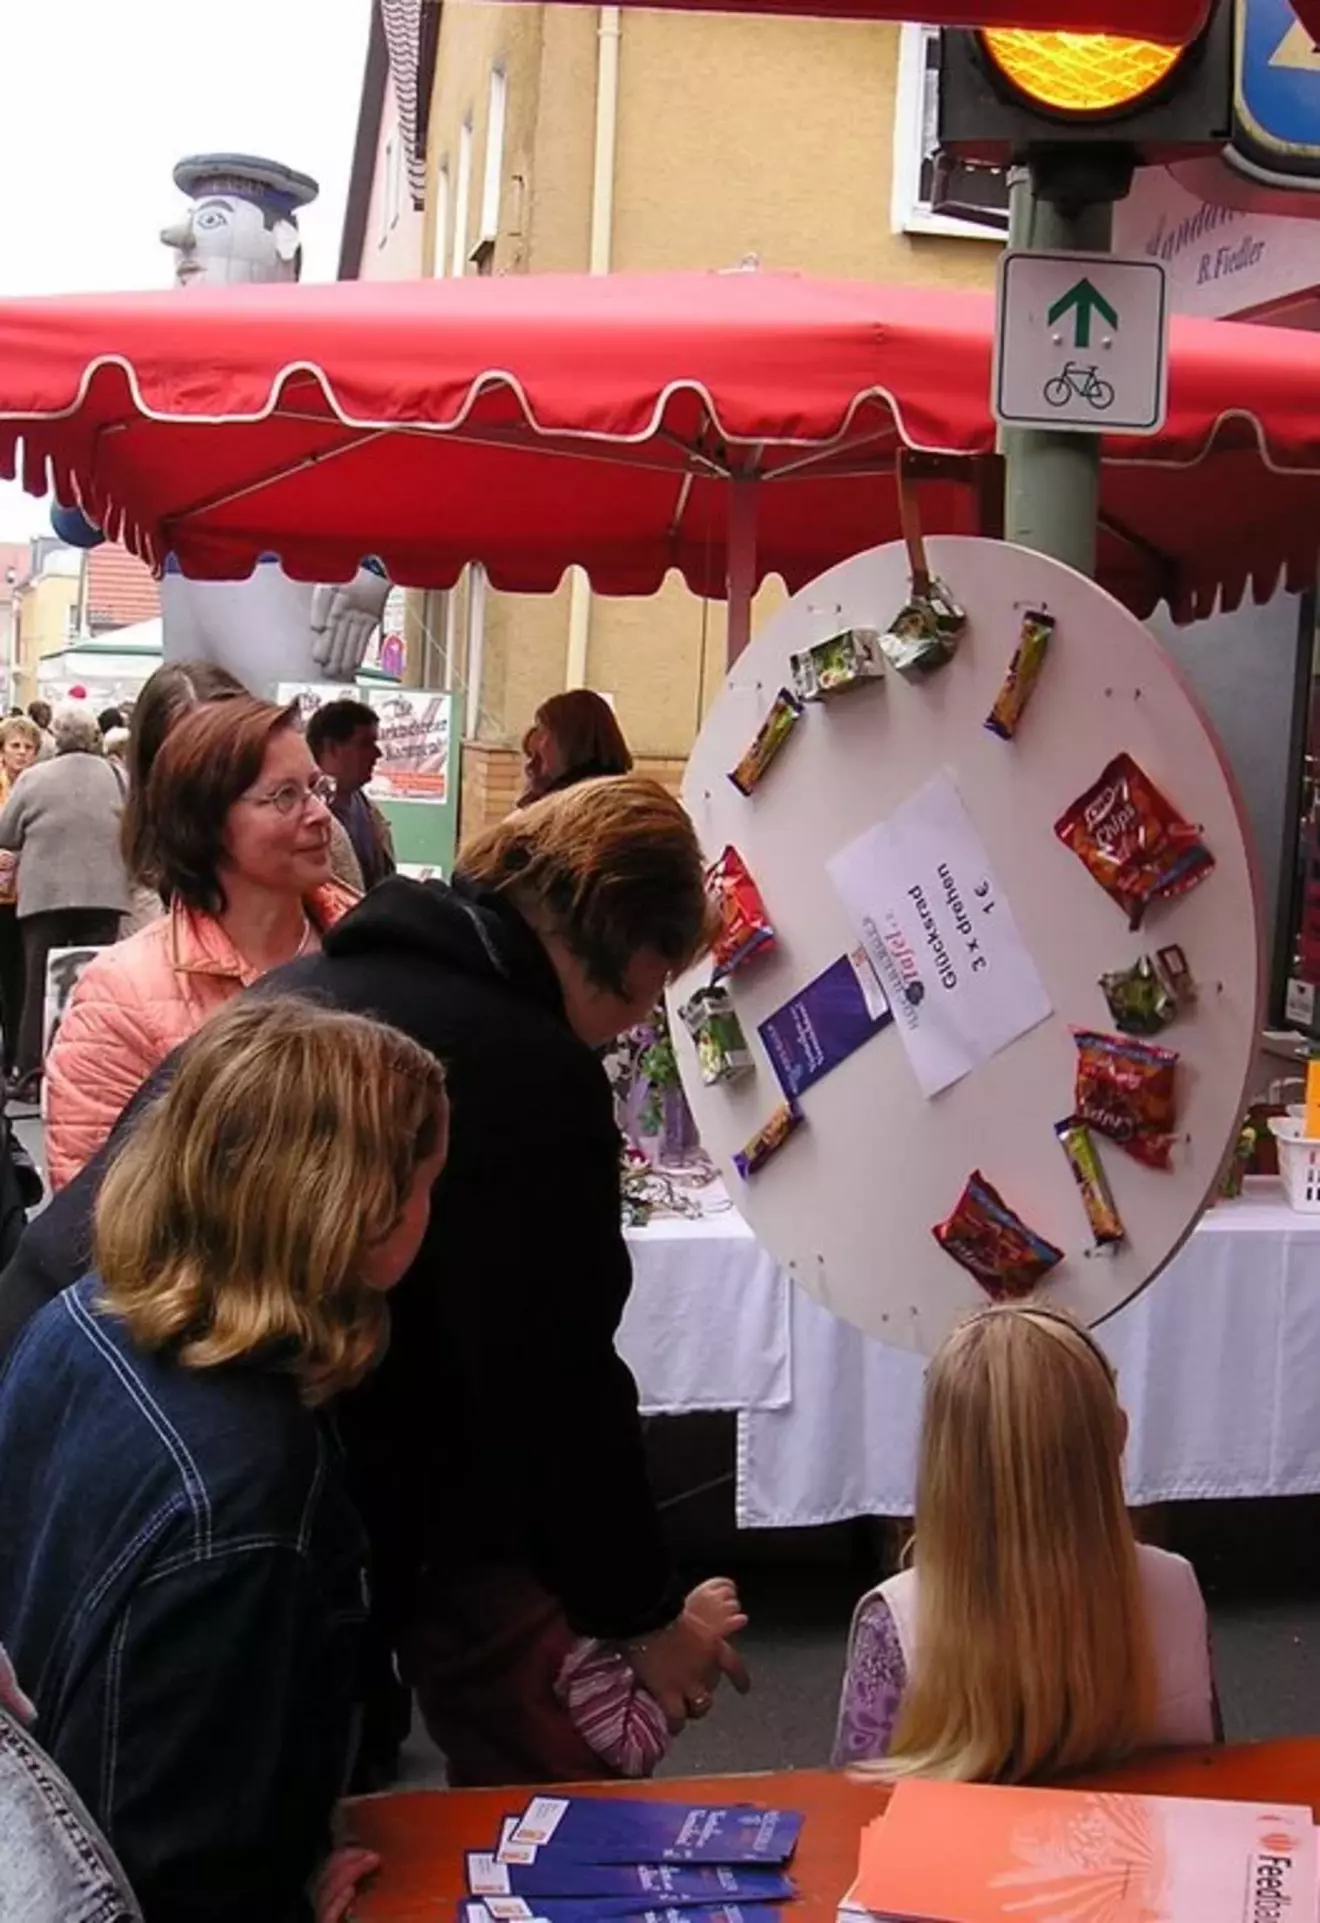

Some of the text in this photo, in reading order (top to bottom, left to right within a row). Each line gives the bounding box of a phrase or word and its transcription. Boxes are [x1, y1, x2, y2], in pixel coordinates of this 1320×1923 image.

[1096, 804, 1135, 850] Chips
[937, 863, 987, 972] 3 x drehen
[974, 881, 995, 914] 1 €
[885, 930, 918, 984] Tafel
[908, 885, 957, 989] Glücksrad
